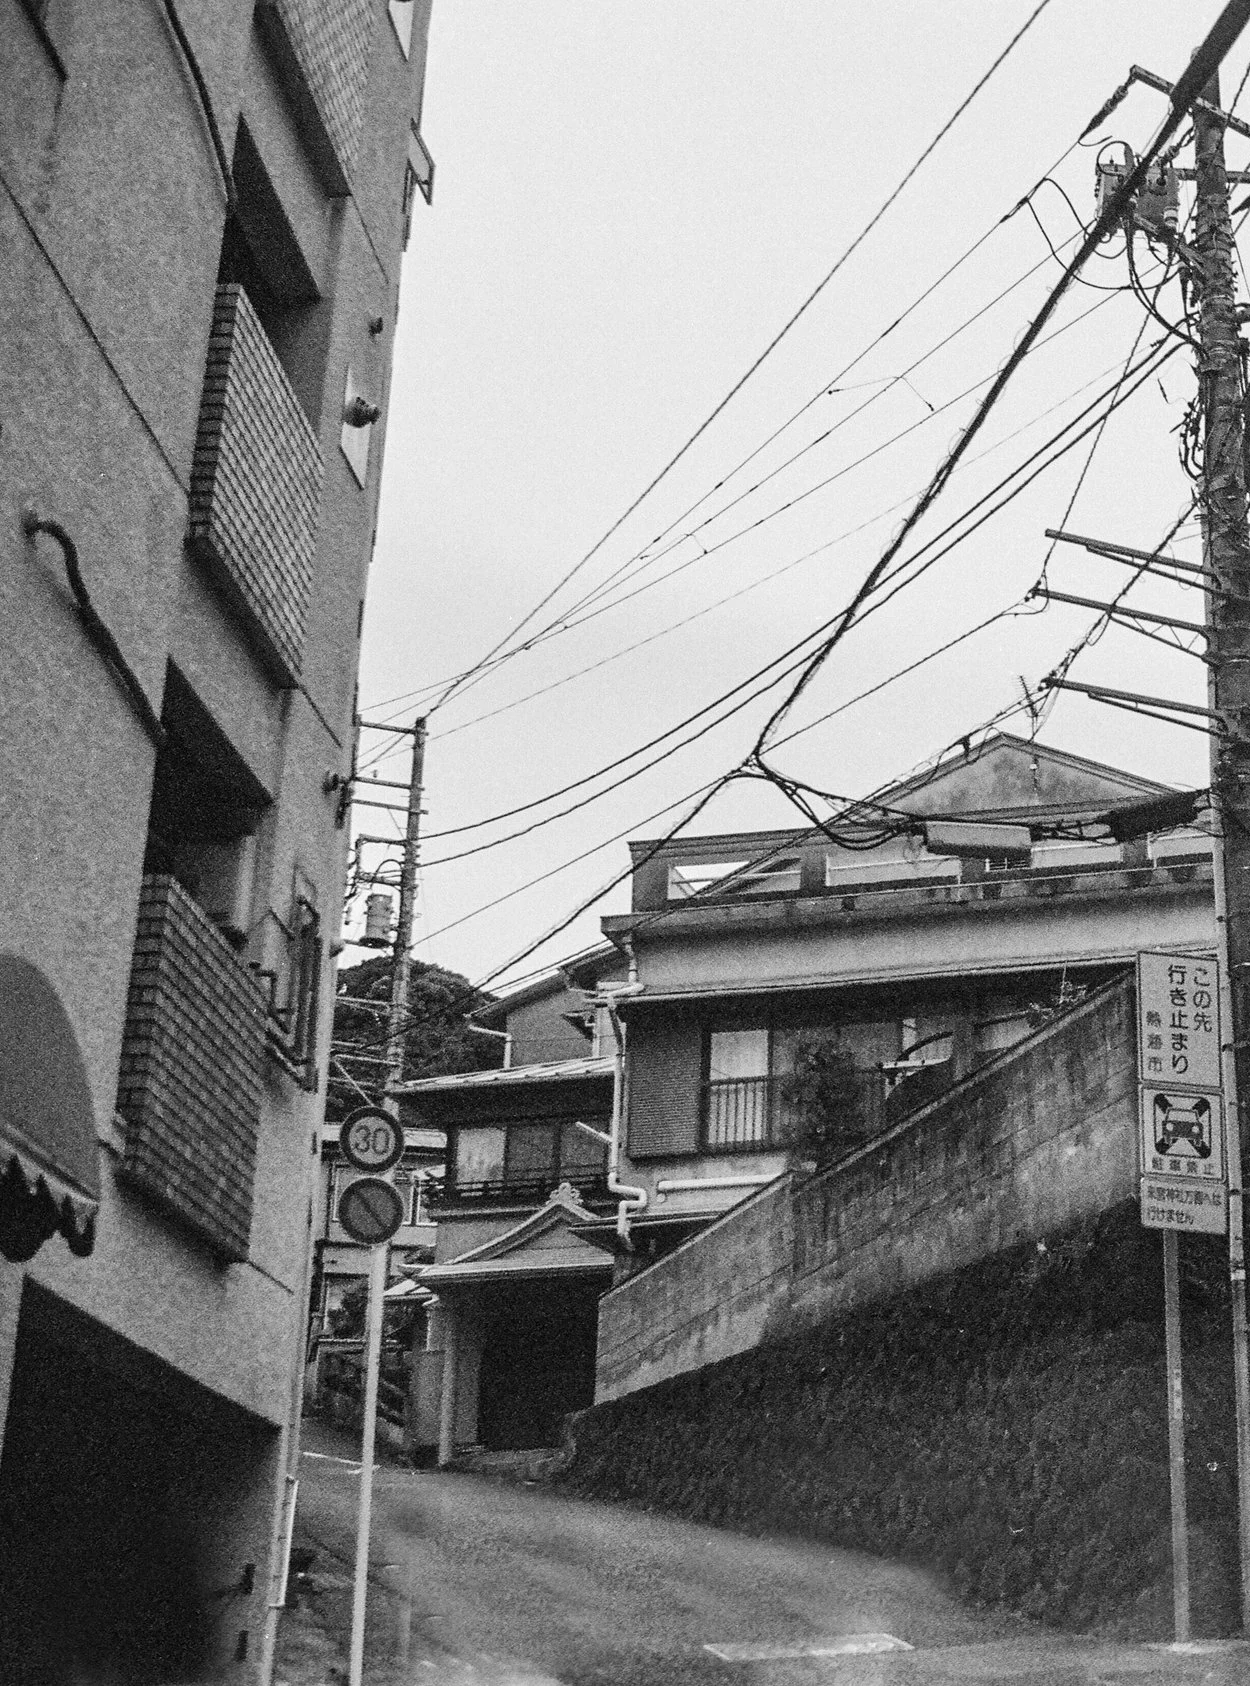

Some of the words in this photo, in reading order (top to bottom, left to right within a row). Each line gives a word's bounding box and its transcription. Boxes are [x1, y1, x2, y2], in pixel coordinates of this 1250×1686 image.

[1168, 964, 1189, 1075] 行き止まり
[1193, 966, 1213, 1034] この先
[355, 1125, 389, 1155] 30
[1147, 1206, 1195, 1225] 行けません
